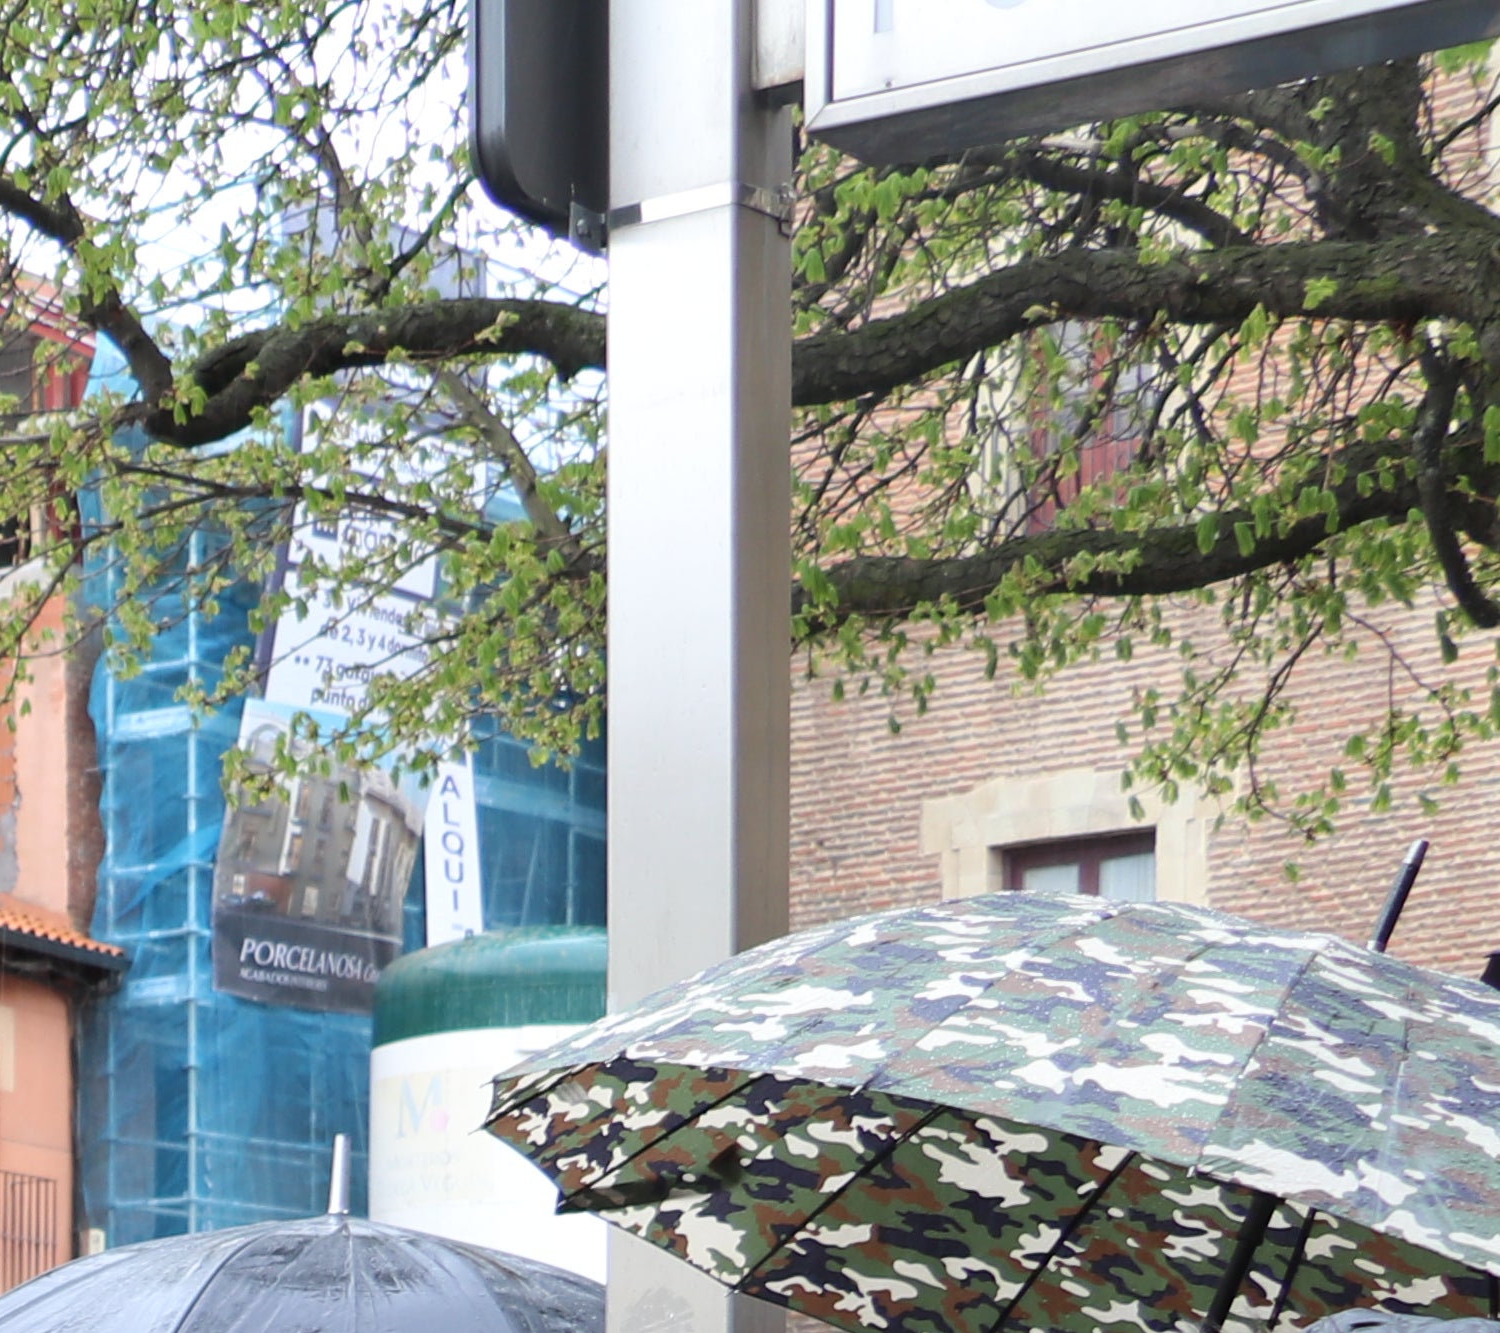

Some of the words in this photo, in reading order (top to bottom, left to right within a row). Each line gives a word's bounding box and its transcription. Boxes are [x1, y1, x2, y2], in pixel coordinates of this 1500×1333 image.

[356, 628, 366, 647] 3
[368, 633, 377, 652] y
[239, 936, 363, 981] PORCELANOSA
